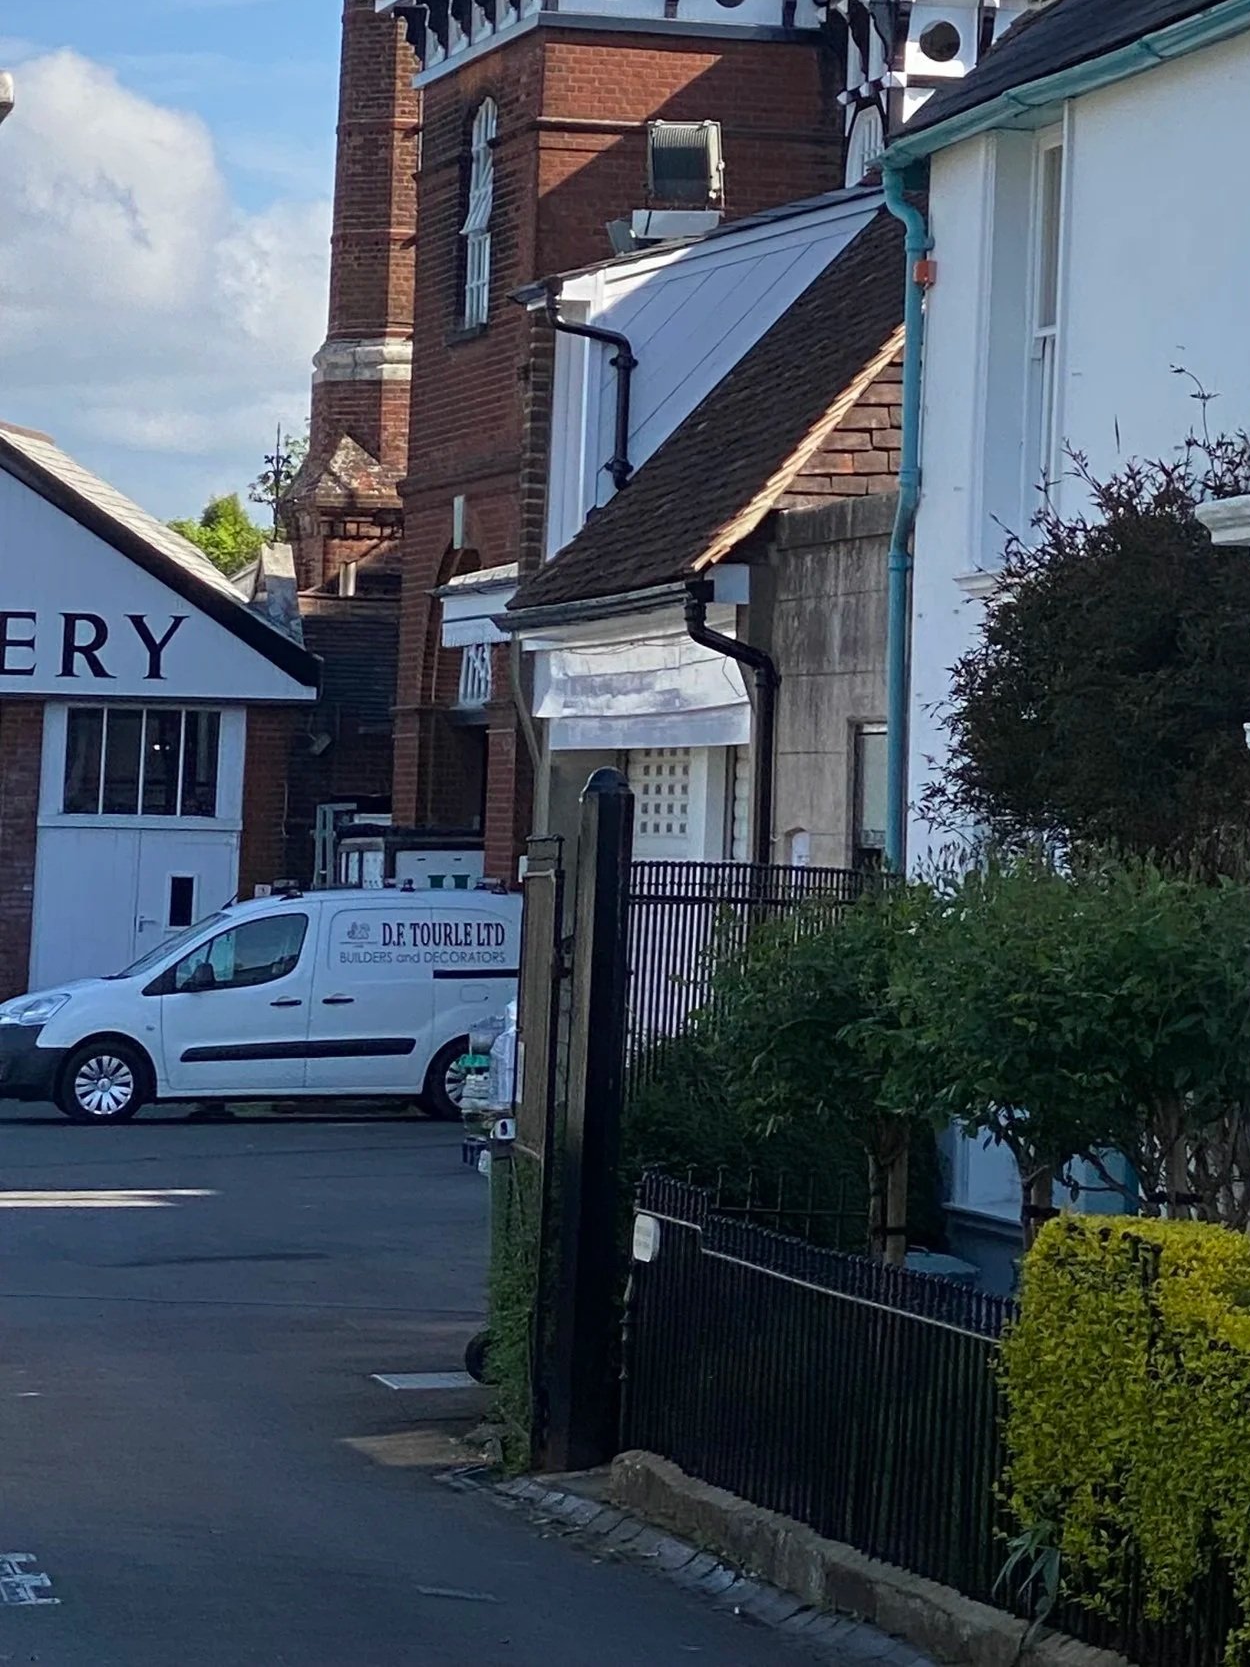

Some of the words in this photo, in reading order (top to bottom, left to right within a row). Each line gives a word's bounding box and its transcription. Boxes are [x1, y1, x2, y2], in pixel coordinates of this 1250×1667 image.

[0, 611, 191, 680] ERY
[410, 922, 472, 947] TOURLE
[476, 922, 505, 947] LTD
[340, 951, 393, 964] BUILDERS
[396, 950, 420, 964] and
[423, 950, 505, 964] DECORATORS
